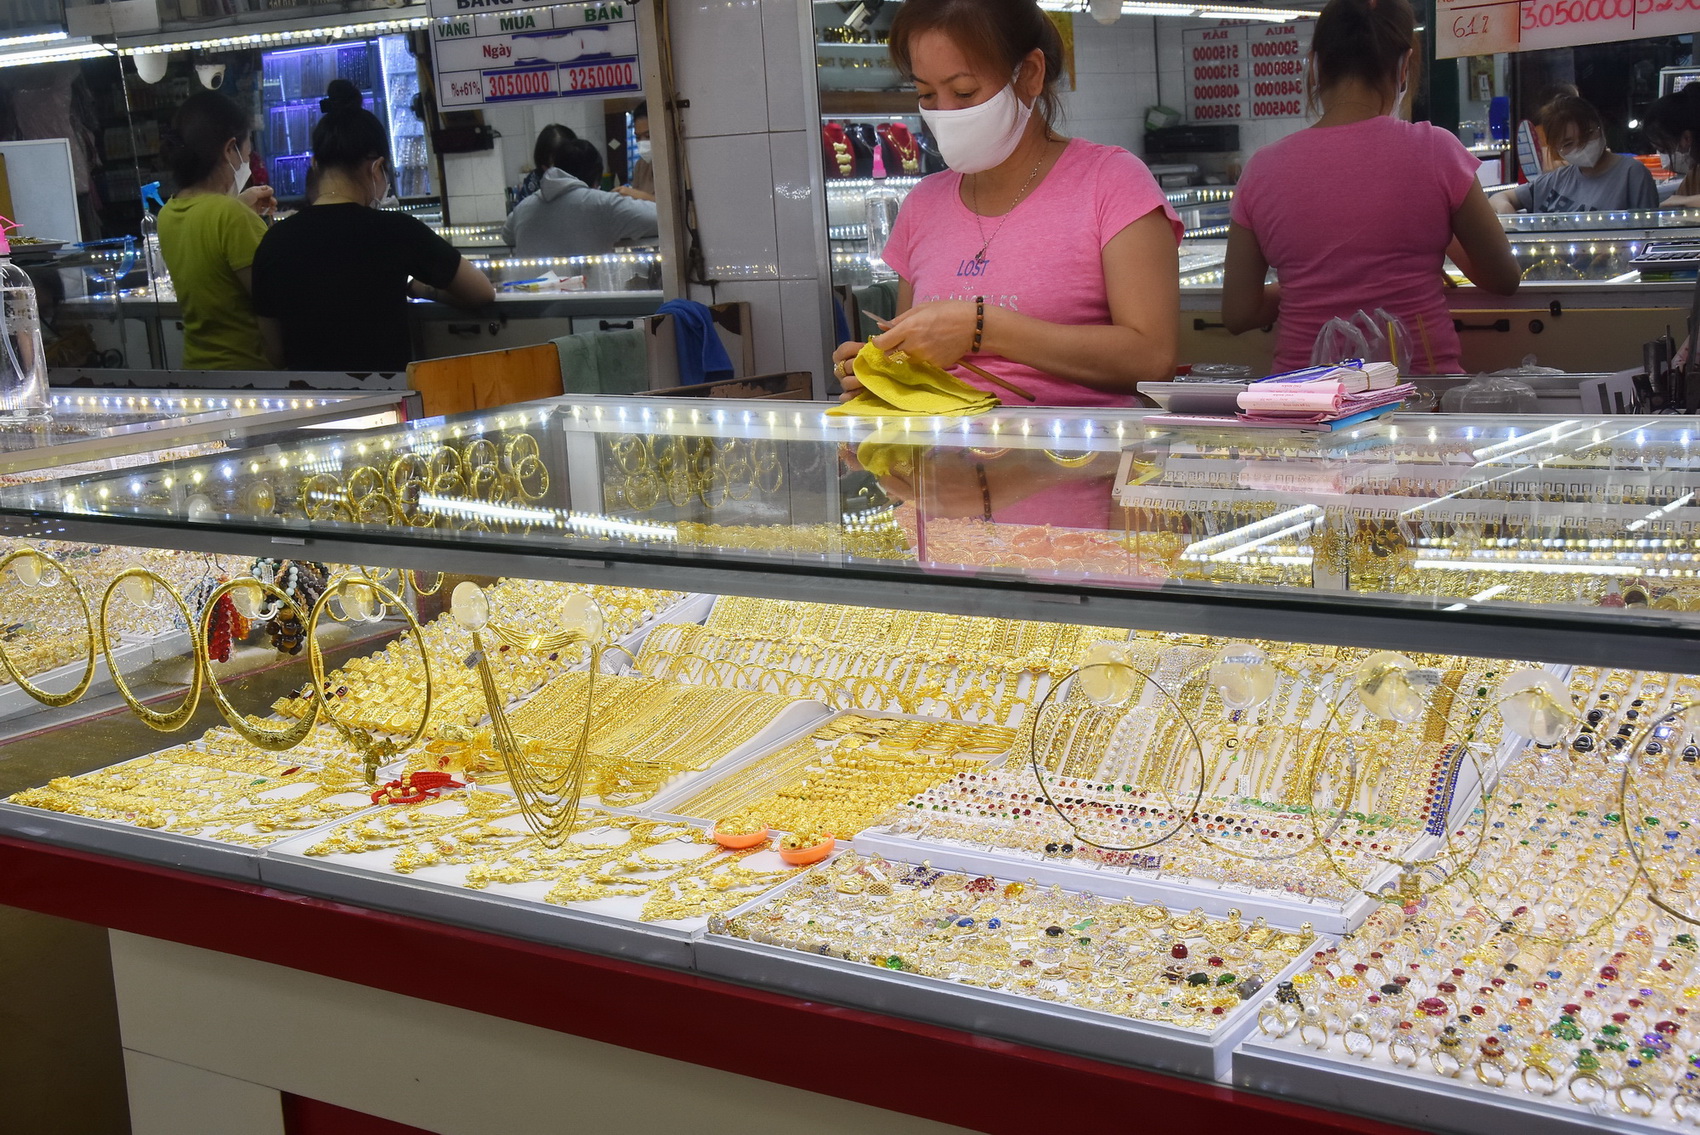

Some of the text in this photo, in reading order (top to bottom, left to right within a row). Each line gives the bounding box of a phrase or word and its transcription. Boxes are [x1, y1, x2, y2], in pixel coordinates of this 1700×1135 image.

[437, 5, 624, 38] VÀNG MUA BÁN
[482, 43, 512, 59] Ngày
[489, 71, 550, 97] 3050000
[569, 63, 633, 90] 3250000
[956, 259, 990, 277] LOST
